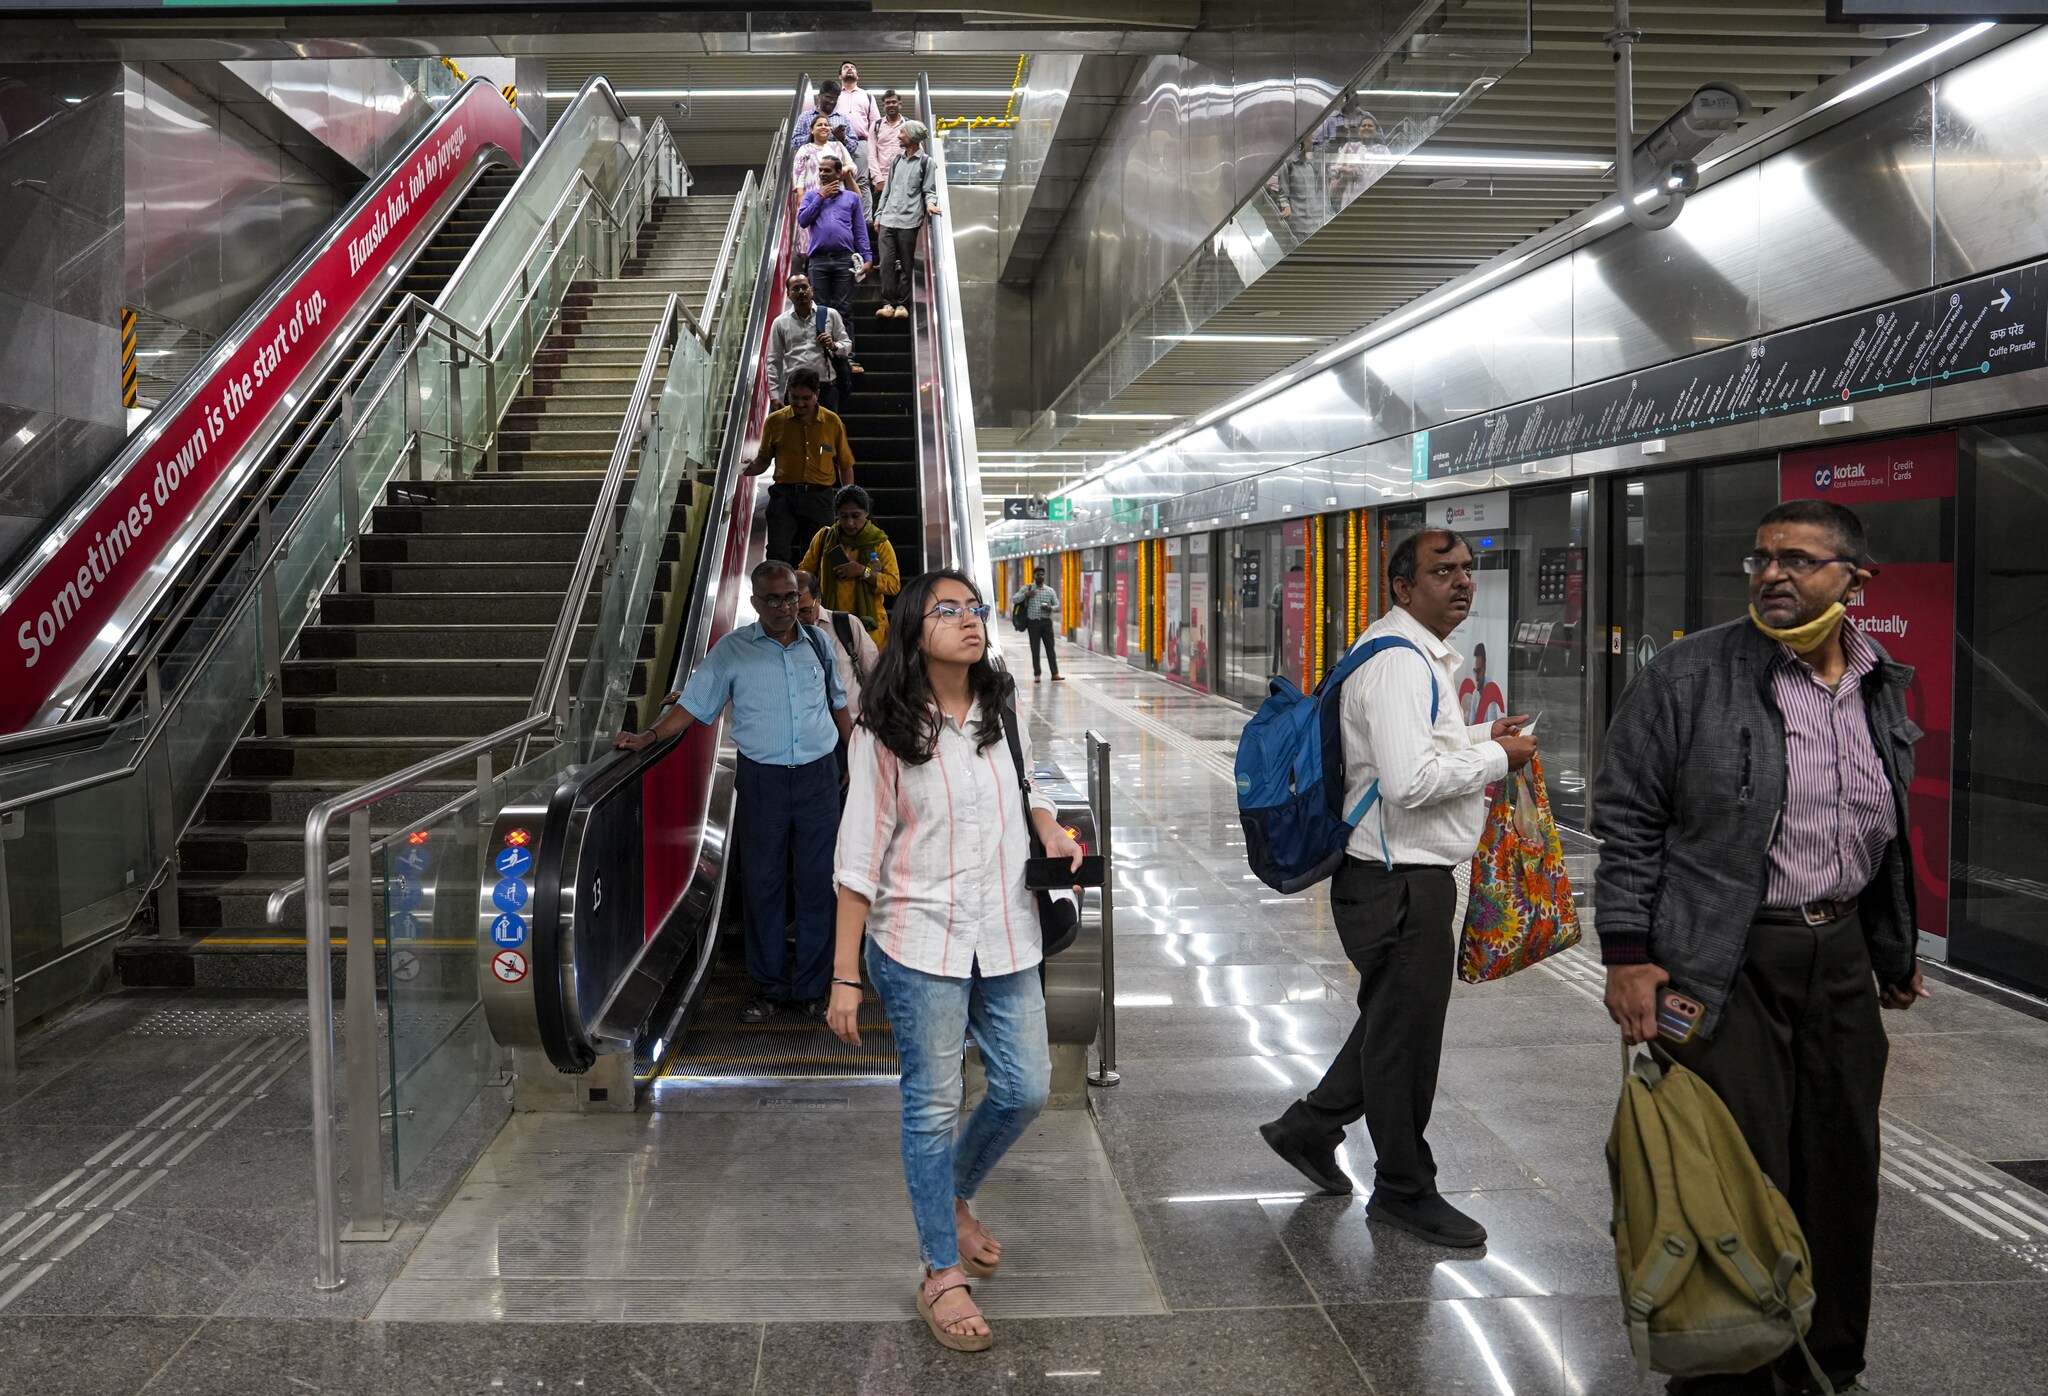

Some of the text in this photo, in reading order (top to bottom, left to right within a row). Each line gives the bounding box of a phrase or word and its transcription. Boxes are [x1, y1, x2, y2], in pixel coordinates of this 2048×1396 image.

[347, 124, 467, 277] Hausla hai, toh ho jayega.
[1922, 359, 1930, 371] LIC
[1930, 322, 1952, 356] Churchgate
[1950, 304, 1963, 322] Metro
[1950, 352, 1959, 365] SBI
[1958, 329, 1974, 350] Vidhan
[1972, 306, 1988, 329] Bhavan
[1990, 322, 2025, 340] कफ परेड
[1860, 318, 1898, 383] Maharaj Terminus Metro
[1989, 340, 2036, 357] Cuffe Parade
[1885, 367, 1893, 378] LIC
[1892, 340, 1908, 365] Hutatma
[1906, 362, 1914, 374] LIC
[1938, 355, 1947, 368] SBI
[1874, 369, 1882, 380] LIC
[1417, 451, 1422, 475] 1
[1833, 463, 1866, 479] kotak
[1893, 460, 1914, 471] Credit
[17, 290, 327, 668] Sometimes down is the start of up.
[1833, 477, 1884, 488] Kotak Mahindra Bank
[1893, 471, 1912, 481] Cards
[1858, 615, 1908, 638] actually
[593, 877, 602, 911] 13
